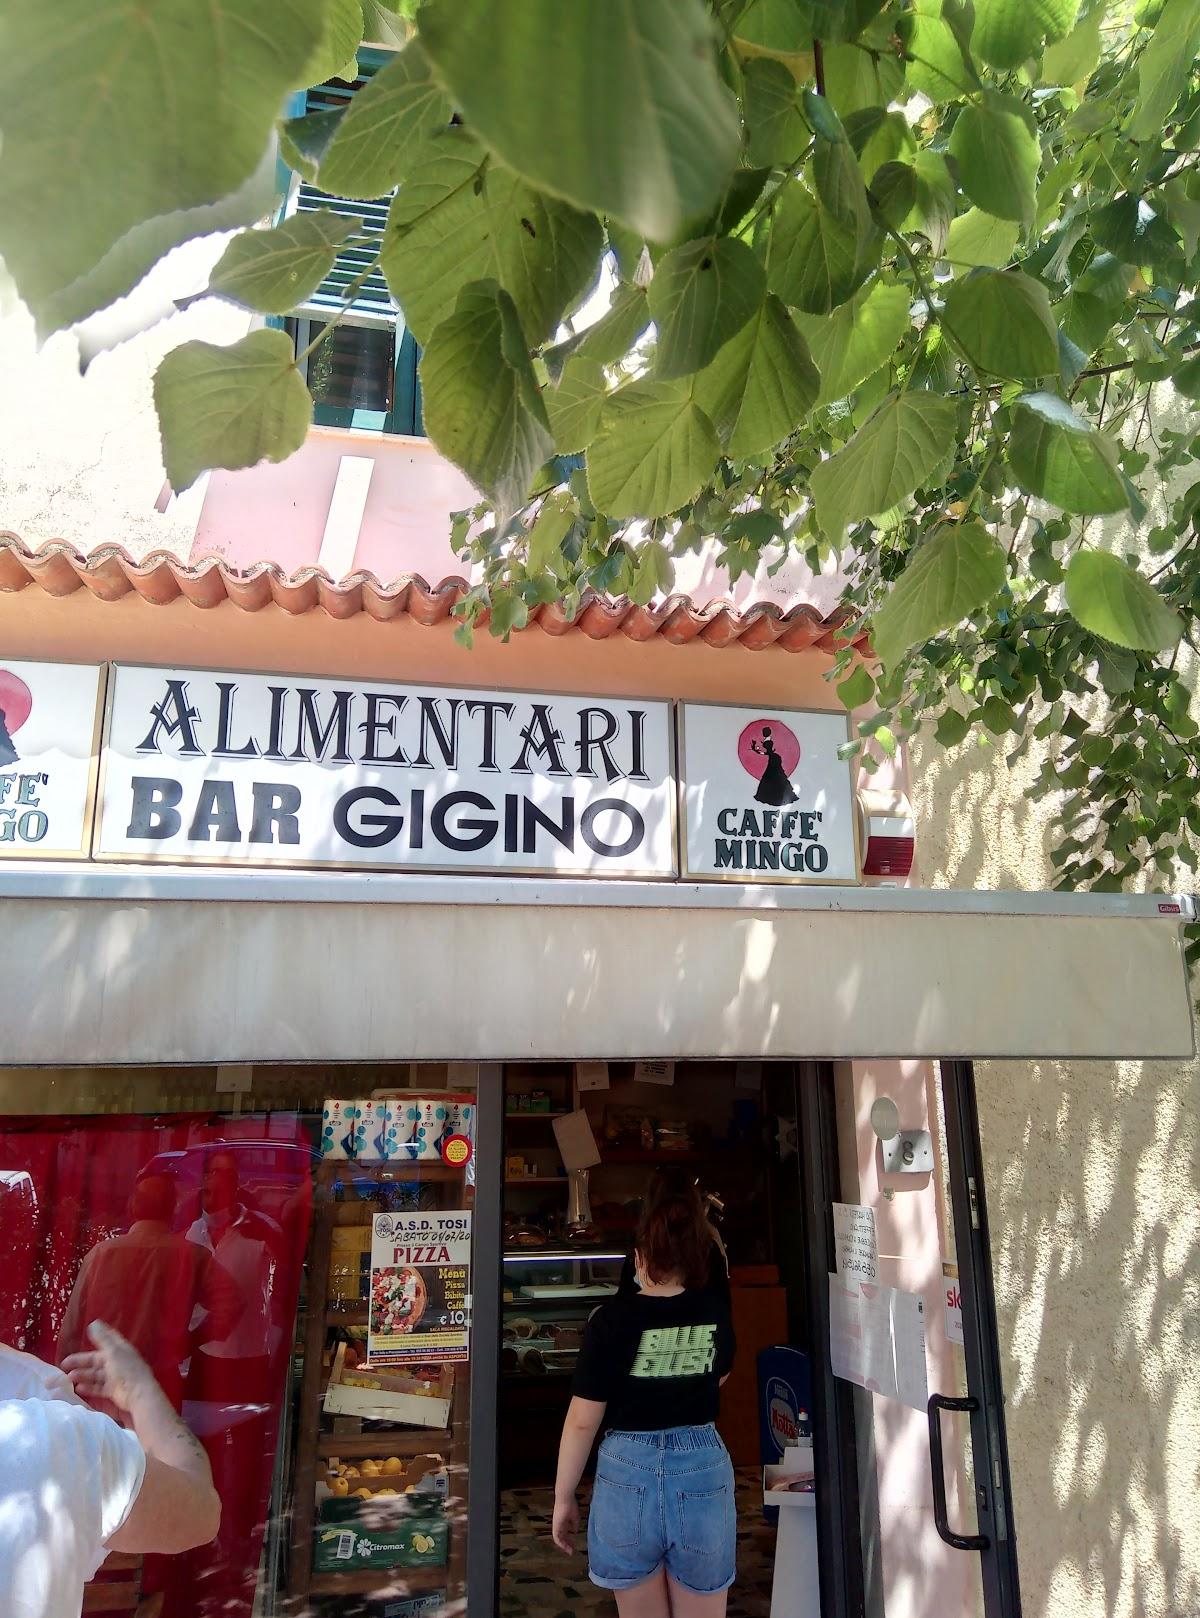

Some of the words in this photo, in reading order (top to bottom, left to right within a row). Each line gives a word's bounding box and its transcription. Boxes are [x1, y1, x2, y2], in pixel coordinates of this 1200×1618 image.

[136, 679, 650, 785] ALIMENTARI
[126, 776, 302, 844] BAR
[332, 785, 646, 857] GIGINO
[717, 808, 823, 841] CAFFE'
[714, 839, 829, 873] MINGO
[395, 1220, 432, 1231] A.S.D.
[437, 1219, 467, 1229] TOSI
[390, 1231, 430, 1242] SABATO
[393, 1246, 451, 1264] PIZZA
[445, 1281, 465, 1289] Pizza
[450, 1310, 465, 1325] 10
[369, 1542, 405, 1552] Citromax
